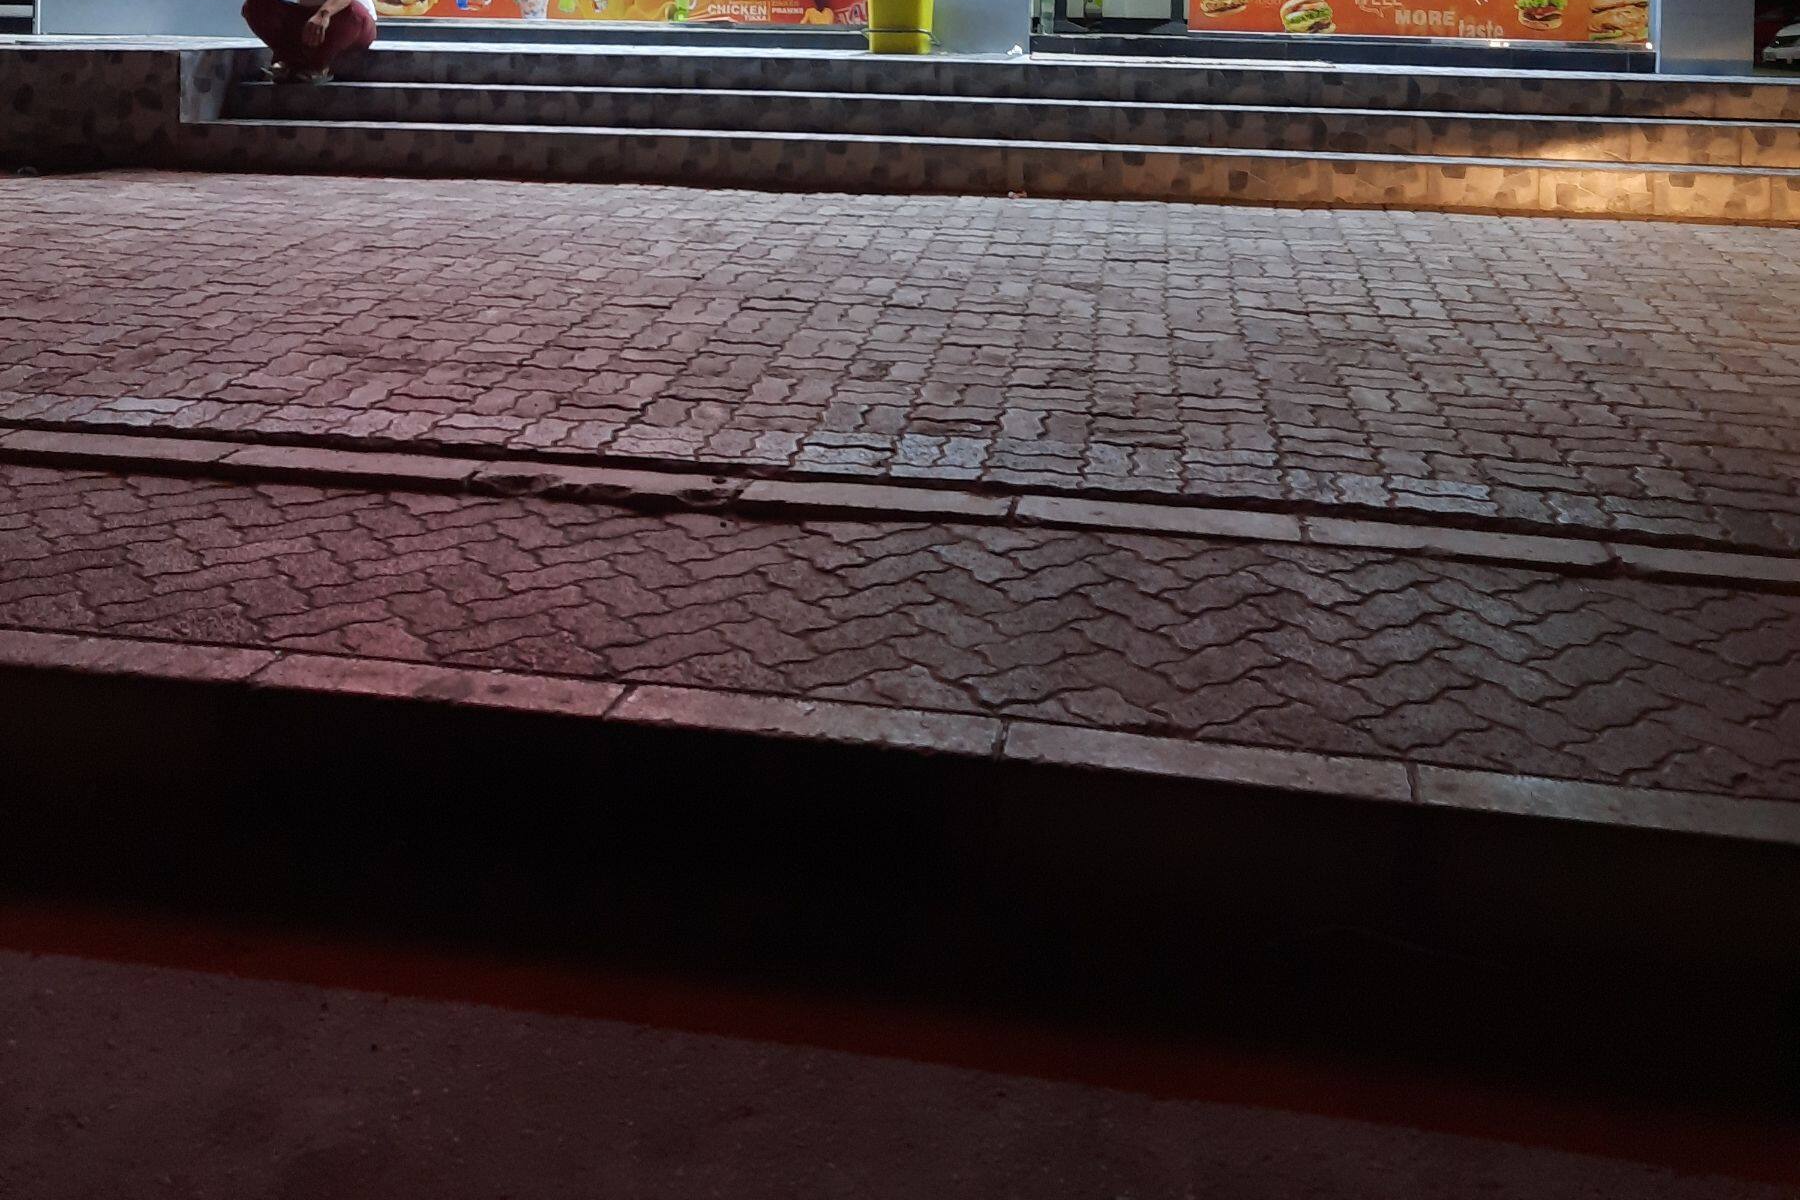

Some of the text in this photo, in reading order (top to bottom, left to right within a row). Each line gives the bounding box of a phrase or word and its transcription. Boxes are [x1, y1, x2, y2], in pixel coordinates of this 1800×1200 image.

[707, 3, 768, 16] CHICKEN
[1395, 9, 1456, 26] MORE
[1458, 20, 1504, 38] taste
